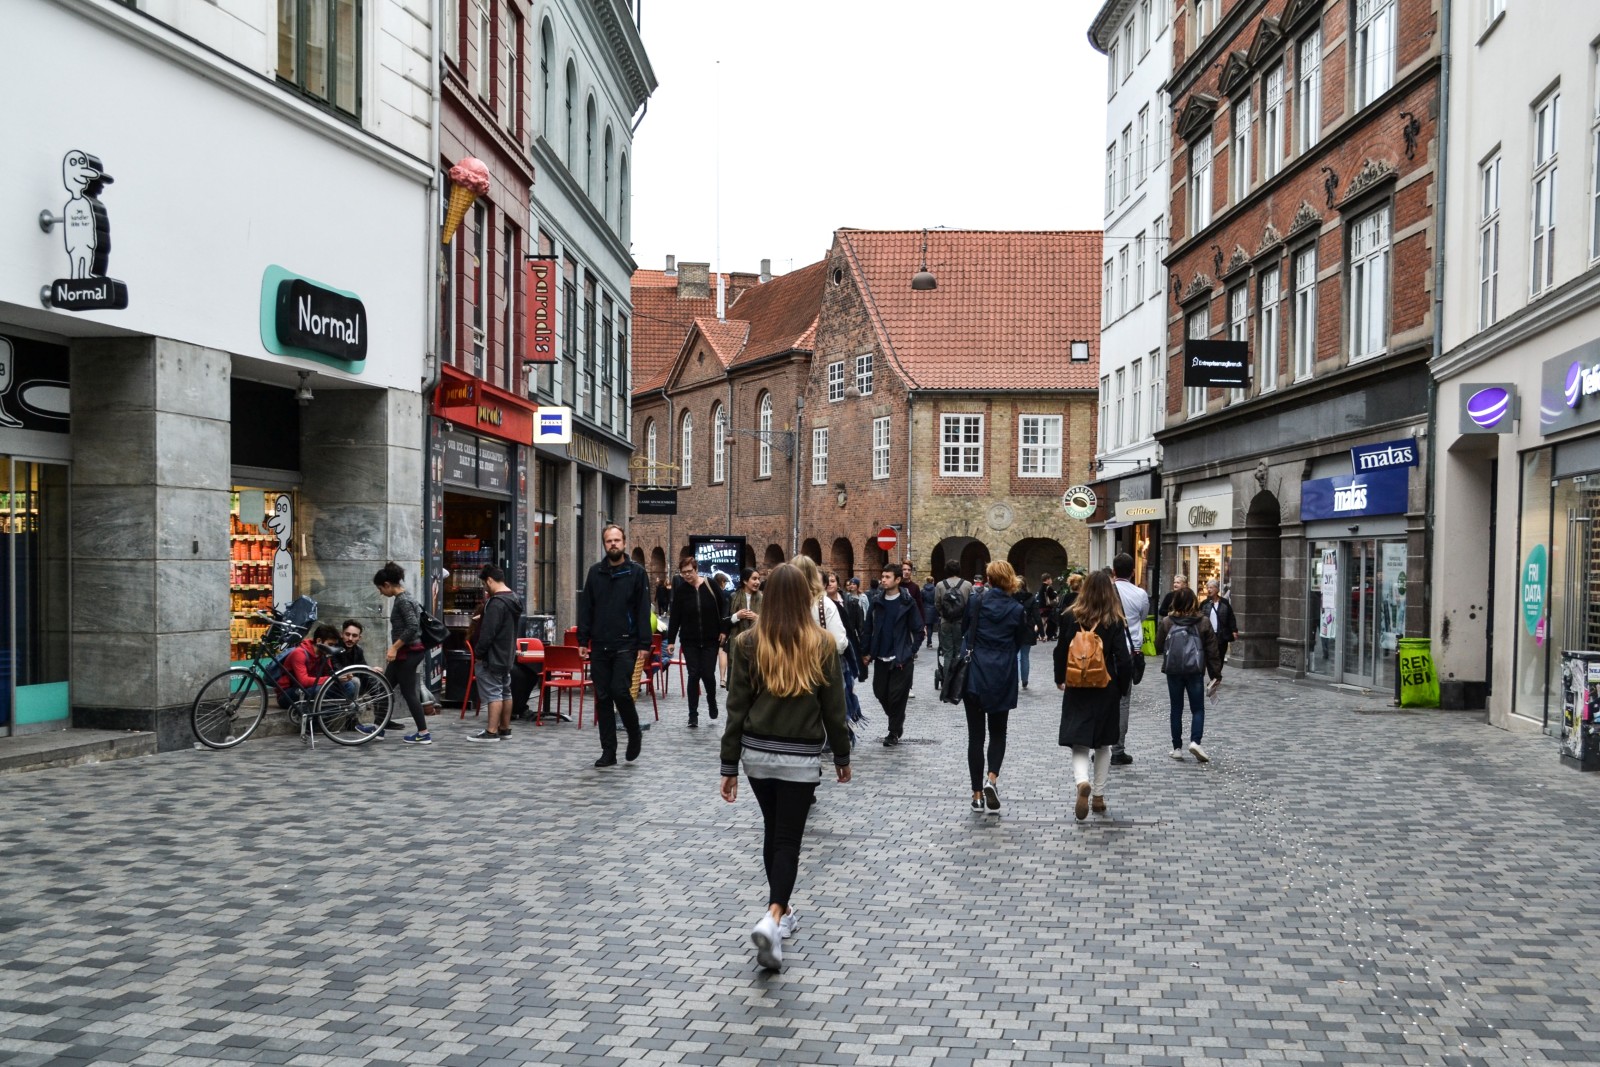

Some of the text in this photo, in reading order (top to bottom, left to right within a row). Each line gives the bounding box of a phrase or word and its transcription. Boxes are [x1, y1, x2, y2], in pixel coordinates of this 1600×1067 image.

[58, 283, 107, 302] Normal
[531, 265, 552, 353] paradis
[298, 294, 360, 345] Normal
[1359, 446, 1413, 469] matas
[1065, 487, 1095, 501] ESPRESSO
[1334, 480, 1368, 511] matas
[1069, 508, 1092, 517] HOUSE
[1126, 506, 1157, 516] Glitter
[1188, 505, 1218, 528] Glitter
[698, 545, 715, 553] PAUL
[1528, 564, 1539, 582] FRI
[1524, 584, 1541, 603] DATA
